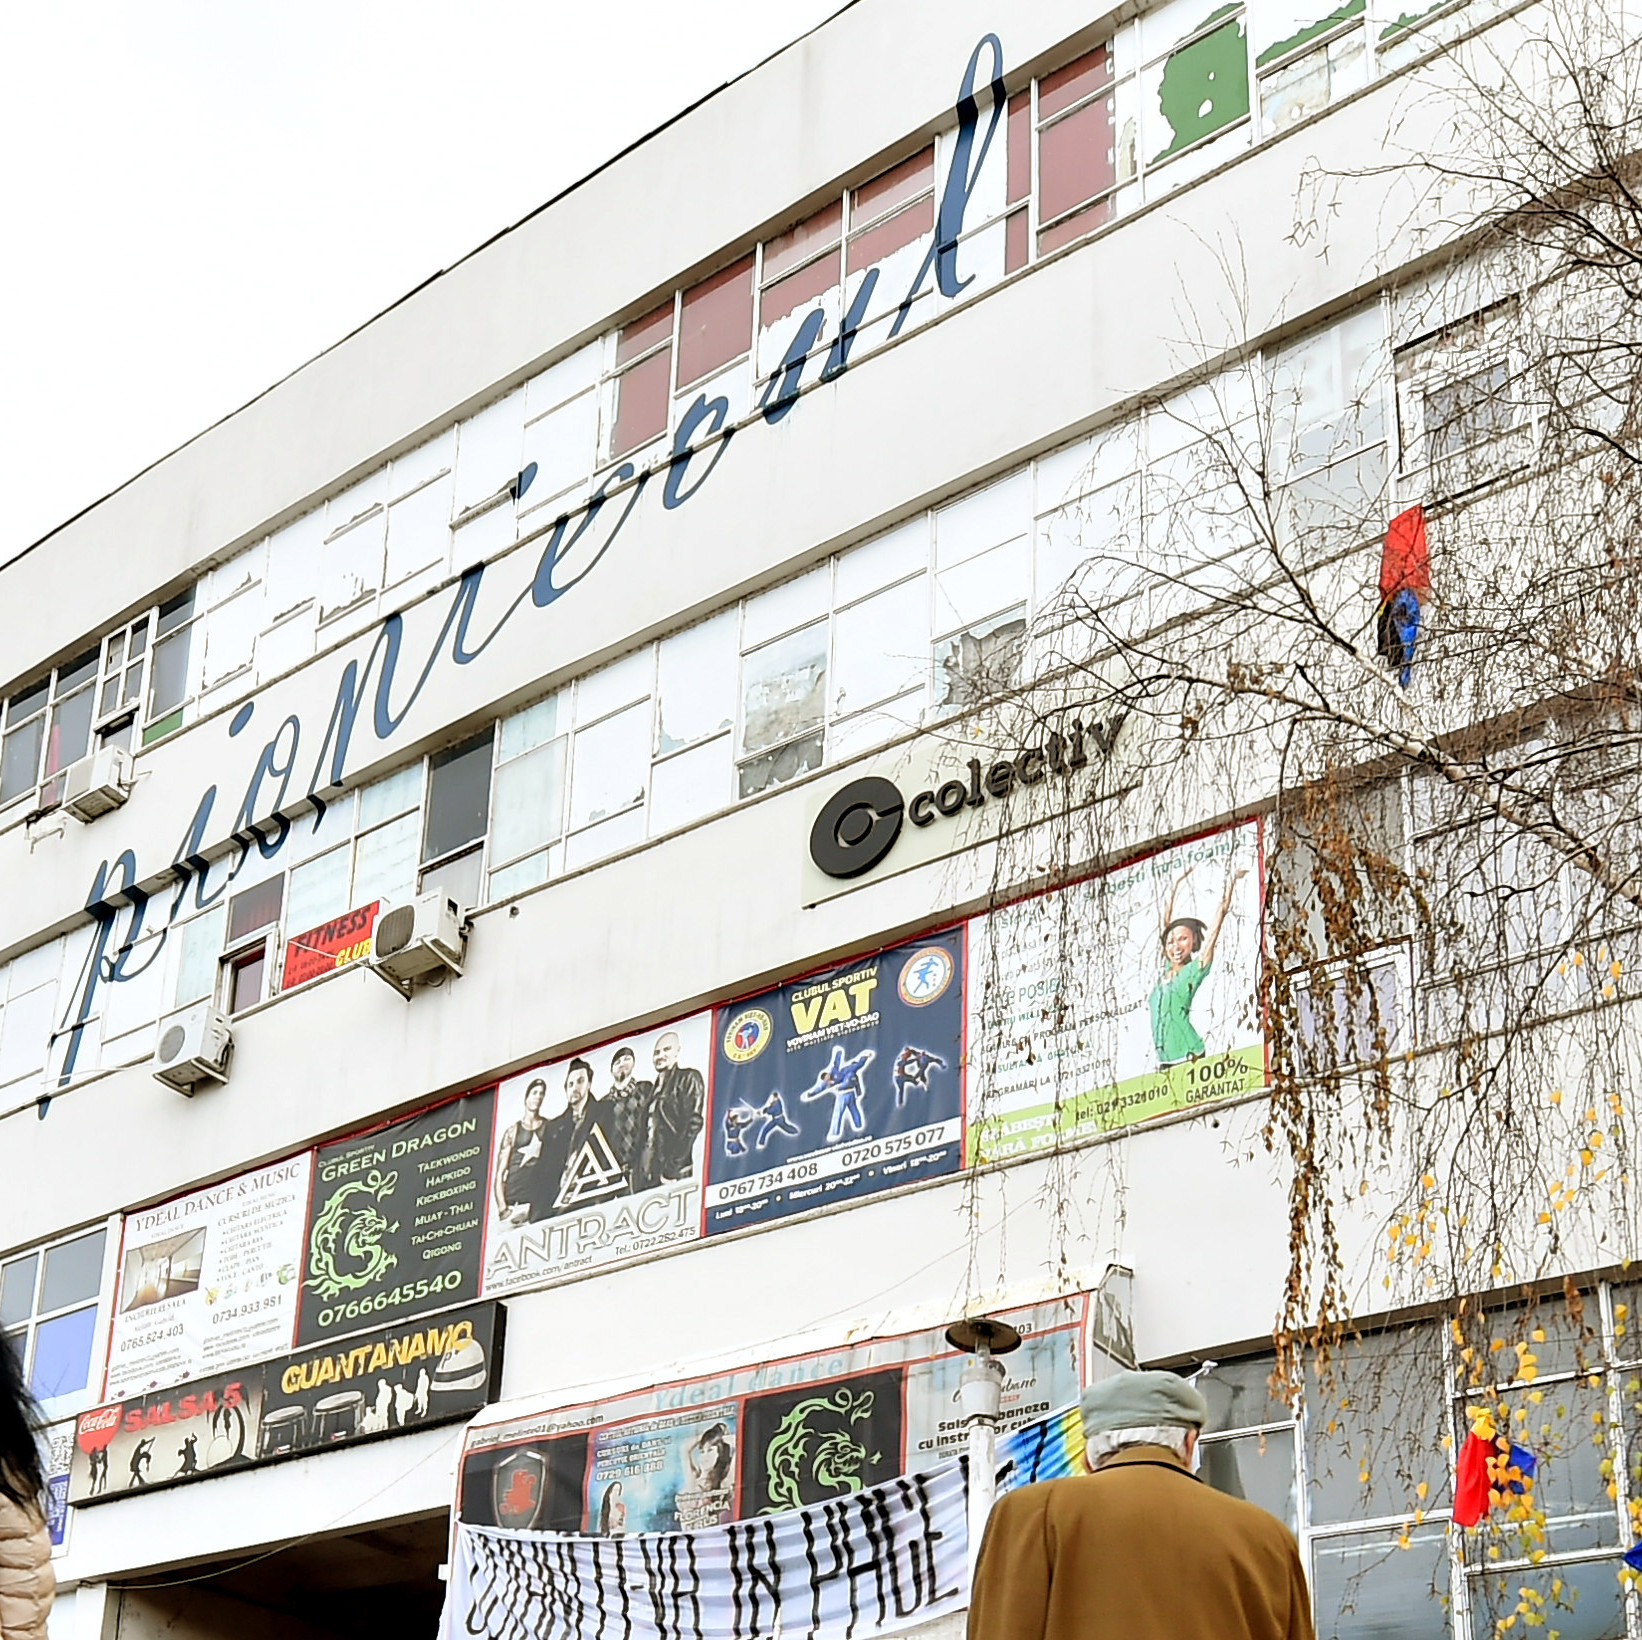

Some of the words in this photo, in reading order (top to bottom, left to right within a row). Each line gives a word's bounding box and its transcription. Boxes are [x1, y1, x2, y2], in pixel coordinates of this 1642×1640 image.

[908, 709, 1128, 828] colectiv
[294, 905, 371, 957] FITNESS
[791, 980, 830, 1002] CLUBUL
[832, 966, 878, 990] SPORTIV
[790, 978, 878, 1035] VAT
[1185, 1077, 1246, 1104] GARANTAT
[1186, 1056, 1249, 1086] 100%
[321, 1149, 387, 1182] GREEN
[391, 1117, 477, 1159] DRAGON
[416, 1146, 481, 1174] TAEKWONDO
[718, 1179, 755, 1200] 0767
[758, 1171, 783, 1191] 734
[787, 1163, 818, 1182] 408
[842, 1145, 881, 1167] 0720
[884, 1135, 912, 1155] 575
[915, 1127, 946, 1146] 077
[184, 1186, 234, 1217] DANCE
[237, 1182, 247, 1197] &
[250, 1162, 301, 1193] MUSIC
[416, 1180, 477, 1207] KICKBOXING
[425, 1166, 472, 1188] HAPKIDO
[421, 1241, 463, 1260] QIGONG
[485, 1184, 700, 1281] ANTRACT
[317, 1270, 463, 1327] 0766645540
[280, 1320, 474, 1395] GUANTANAMO
[746, 1355, 843, 1398] dance
[123, 1391, 219, 1433] SALSA
[674, 1500, 730, 1521] FLORENCIA
